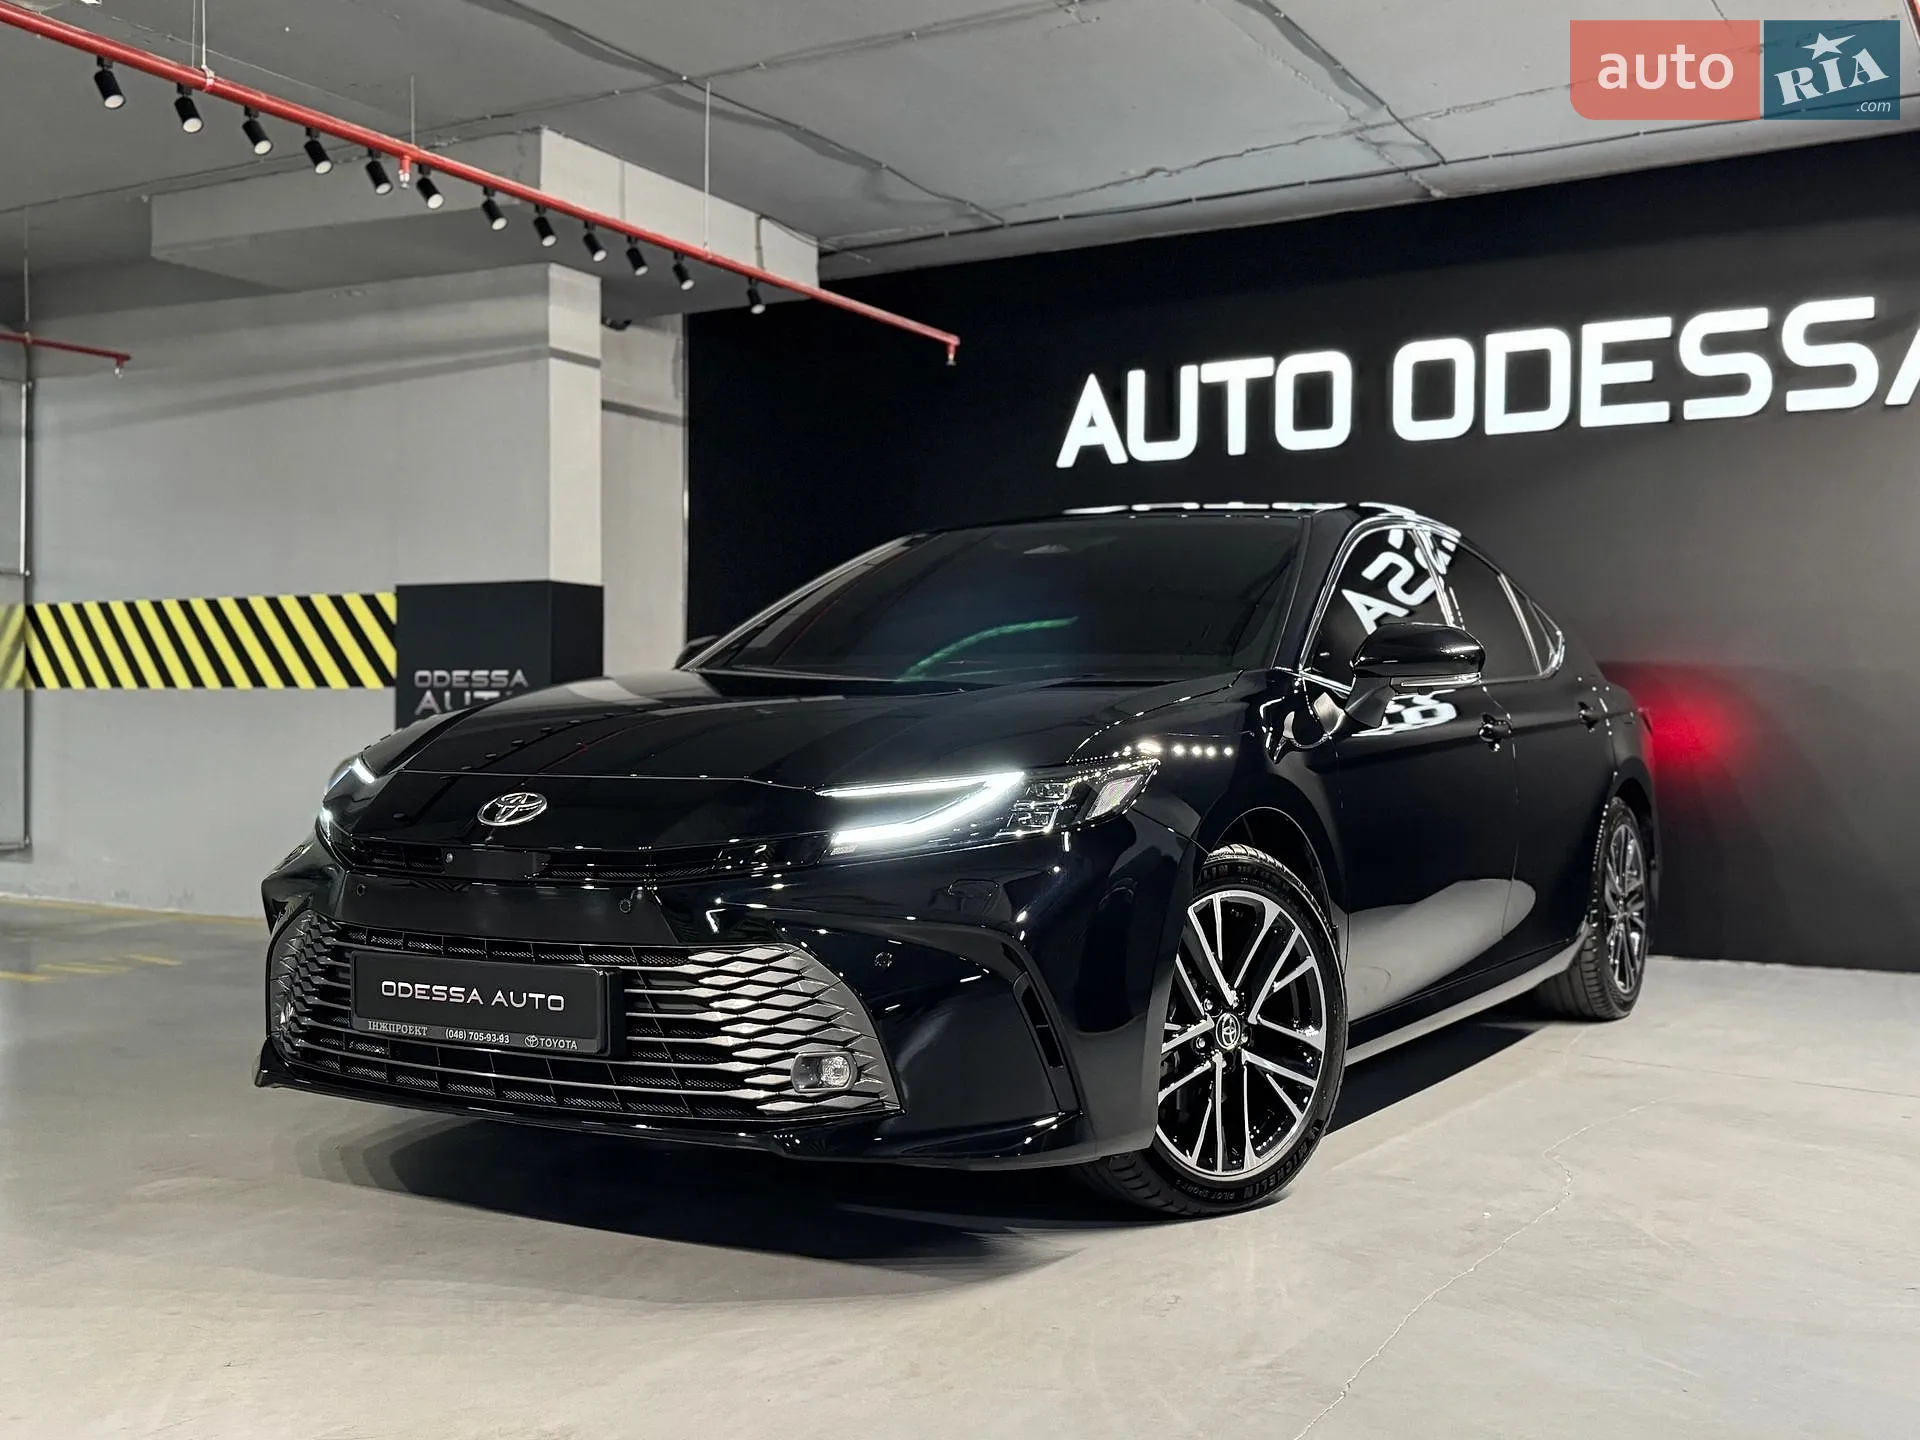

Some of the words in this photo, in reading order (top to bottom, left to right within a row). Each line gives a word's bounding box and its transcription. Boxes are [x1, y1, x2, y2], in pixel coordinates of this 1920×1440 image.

[1056, 350, 1353, 468] AUTO
[414, 668, 529, 688] ODESSA
[414, 690, 513, 716] AUT
[380, 980, 484, 1006] ODESSA
[491, 988, 565, 1012] AUTO
[445, 1027, 467, 1041] (048)
[468, 1031, 510, 1044] 705-93-93
[539, 1037, 578, 1050] TOYOTA
